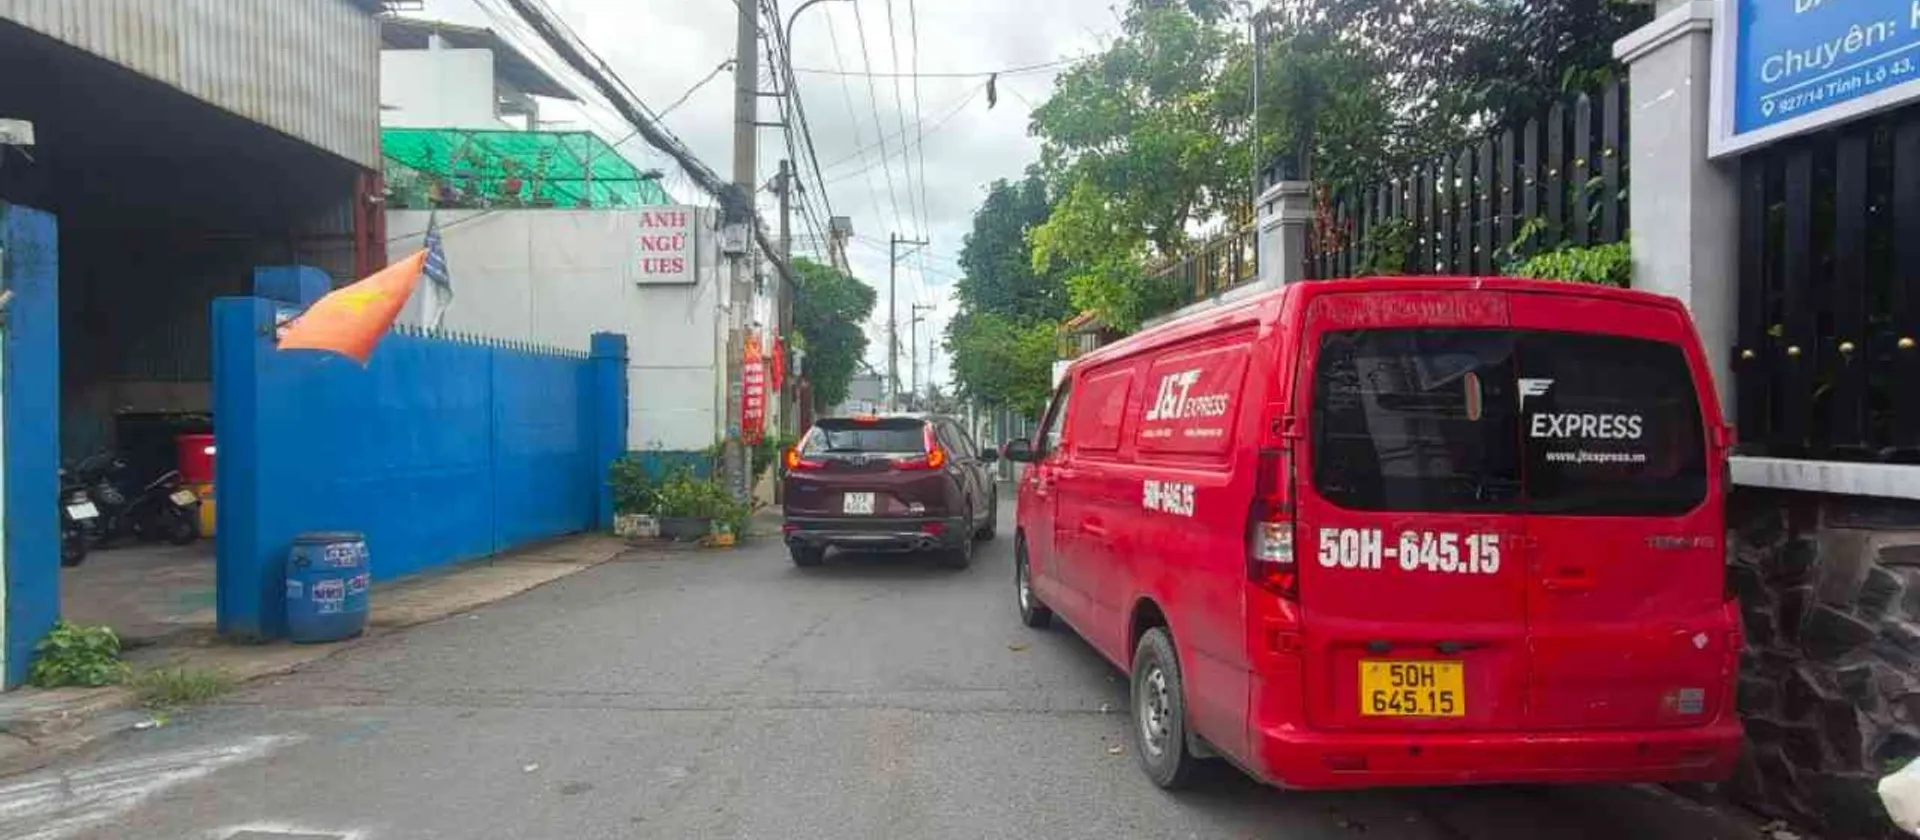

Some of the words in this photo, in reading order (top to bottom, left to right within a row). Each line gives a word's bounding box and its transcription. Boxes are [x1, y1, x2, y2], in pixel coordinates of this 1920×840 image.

[1761, 20, 1896, 83] Chuyên:
[639, 211, 686, 228] ANH
[641, 257, 685, 274] UES
[1146, 367, 1203, 420] J&T
[1183, 393, 1230, 418] EXPRESS
[1530, 413, 1643, 439] EXPRESS
[1546, 450, 1646, 465] www.jtexpress.vn
[1318, 527, 1500, 574] 50H-645.15
[1390, 664, 1435, 687] 50H
[1373, 690, 1454, 713] 645.15
